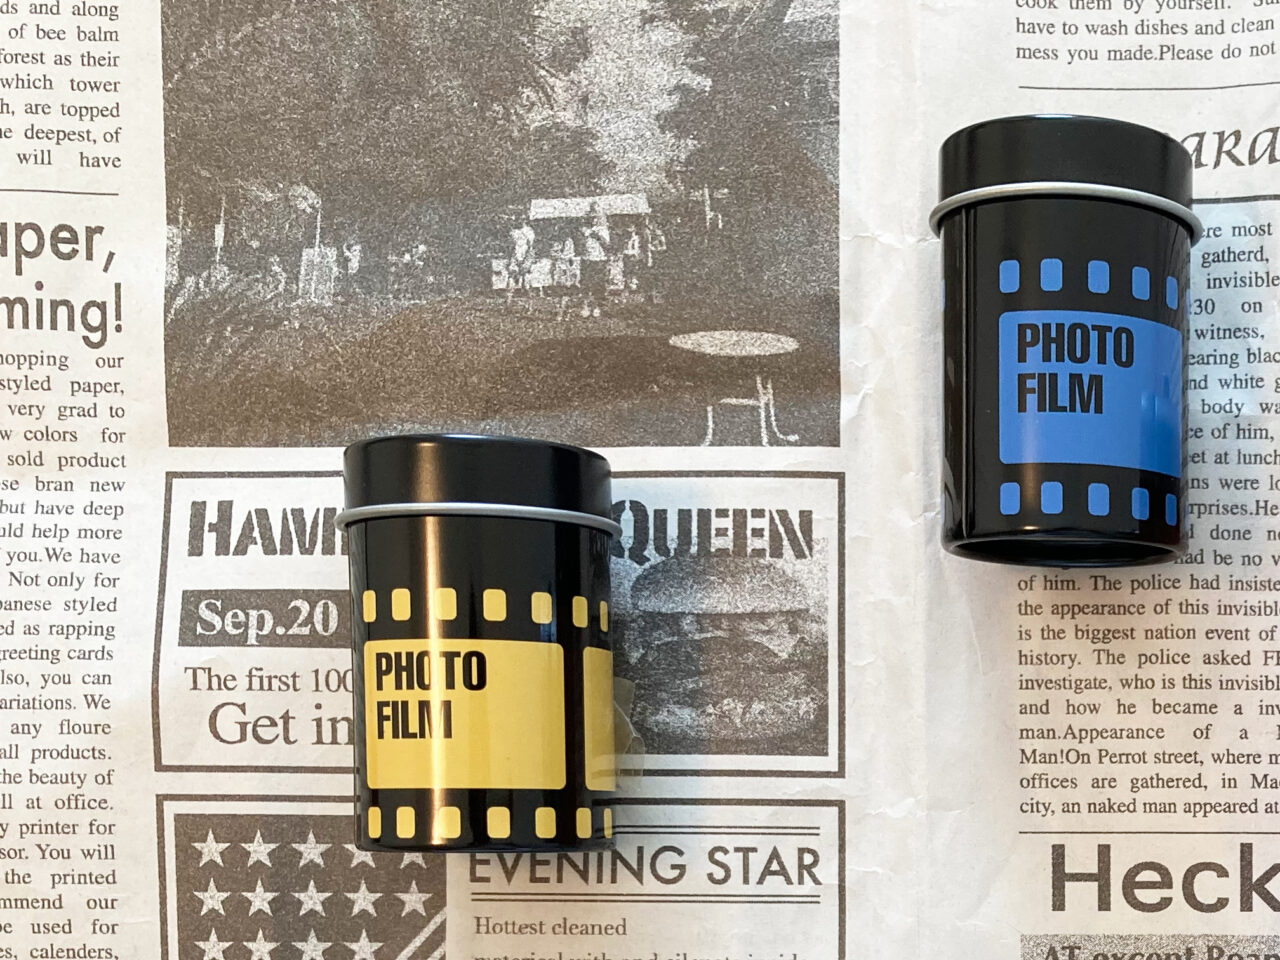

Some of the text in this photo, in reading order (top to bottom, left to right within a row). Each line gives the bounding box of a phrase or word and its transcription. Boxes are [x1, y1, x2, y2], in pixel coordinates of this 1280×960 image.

[1016, 47, 1058, 60] mess
[1068, 49, 1098, 64] you
[1221, 44, 1241, 59] do
[1250, 42, 1275, 56] not
[17, 149, 121, 168] will have
[1018, 323, 1134, 368] PHOTO
[1018, 372, 1103, 414] FILM
[610, 499, 814, 566] QUEEN
[9, 572, 120, 591] Not only for
[196, 599, 339, 645] Sep.20
[184, 666, 237, 692] The
[246, 667, 301, 692] first
[376, 650, 487, 691] PHOTO
[208, 702, 298, 745] Get
[377, 700, 452, 739] FILM
[470, 845, 823, 886] EVENING STAR
[474, 916, 627, 935] Hottest cleaned
